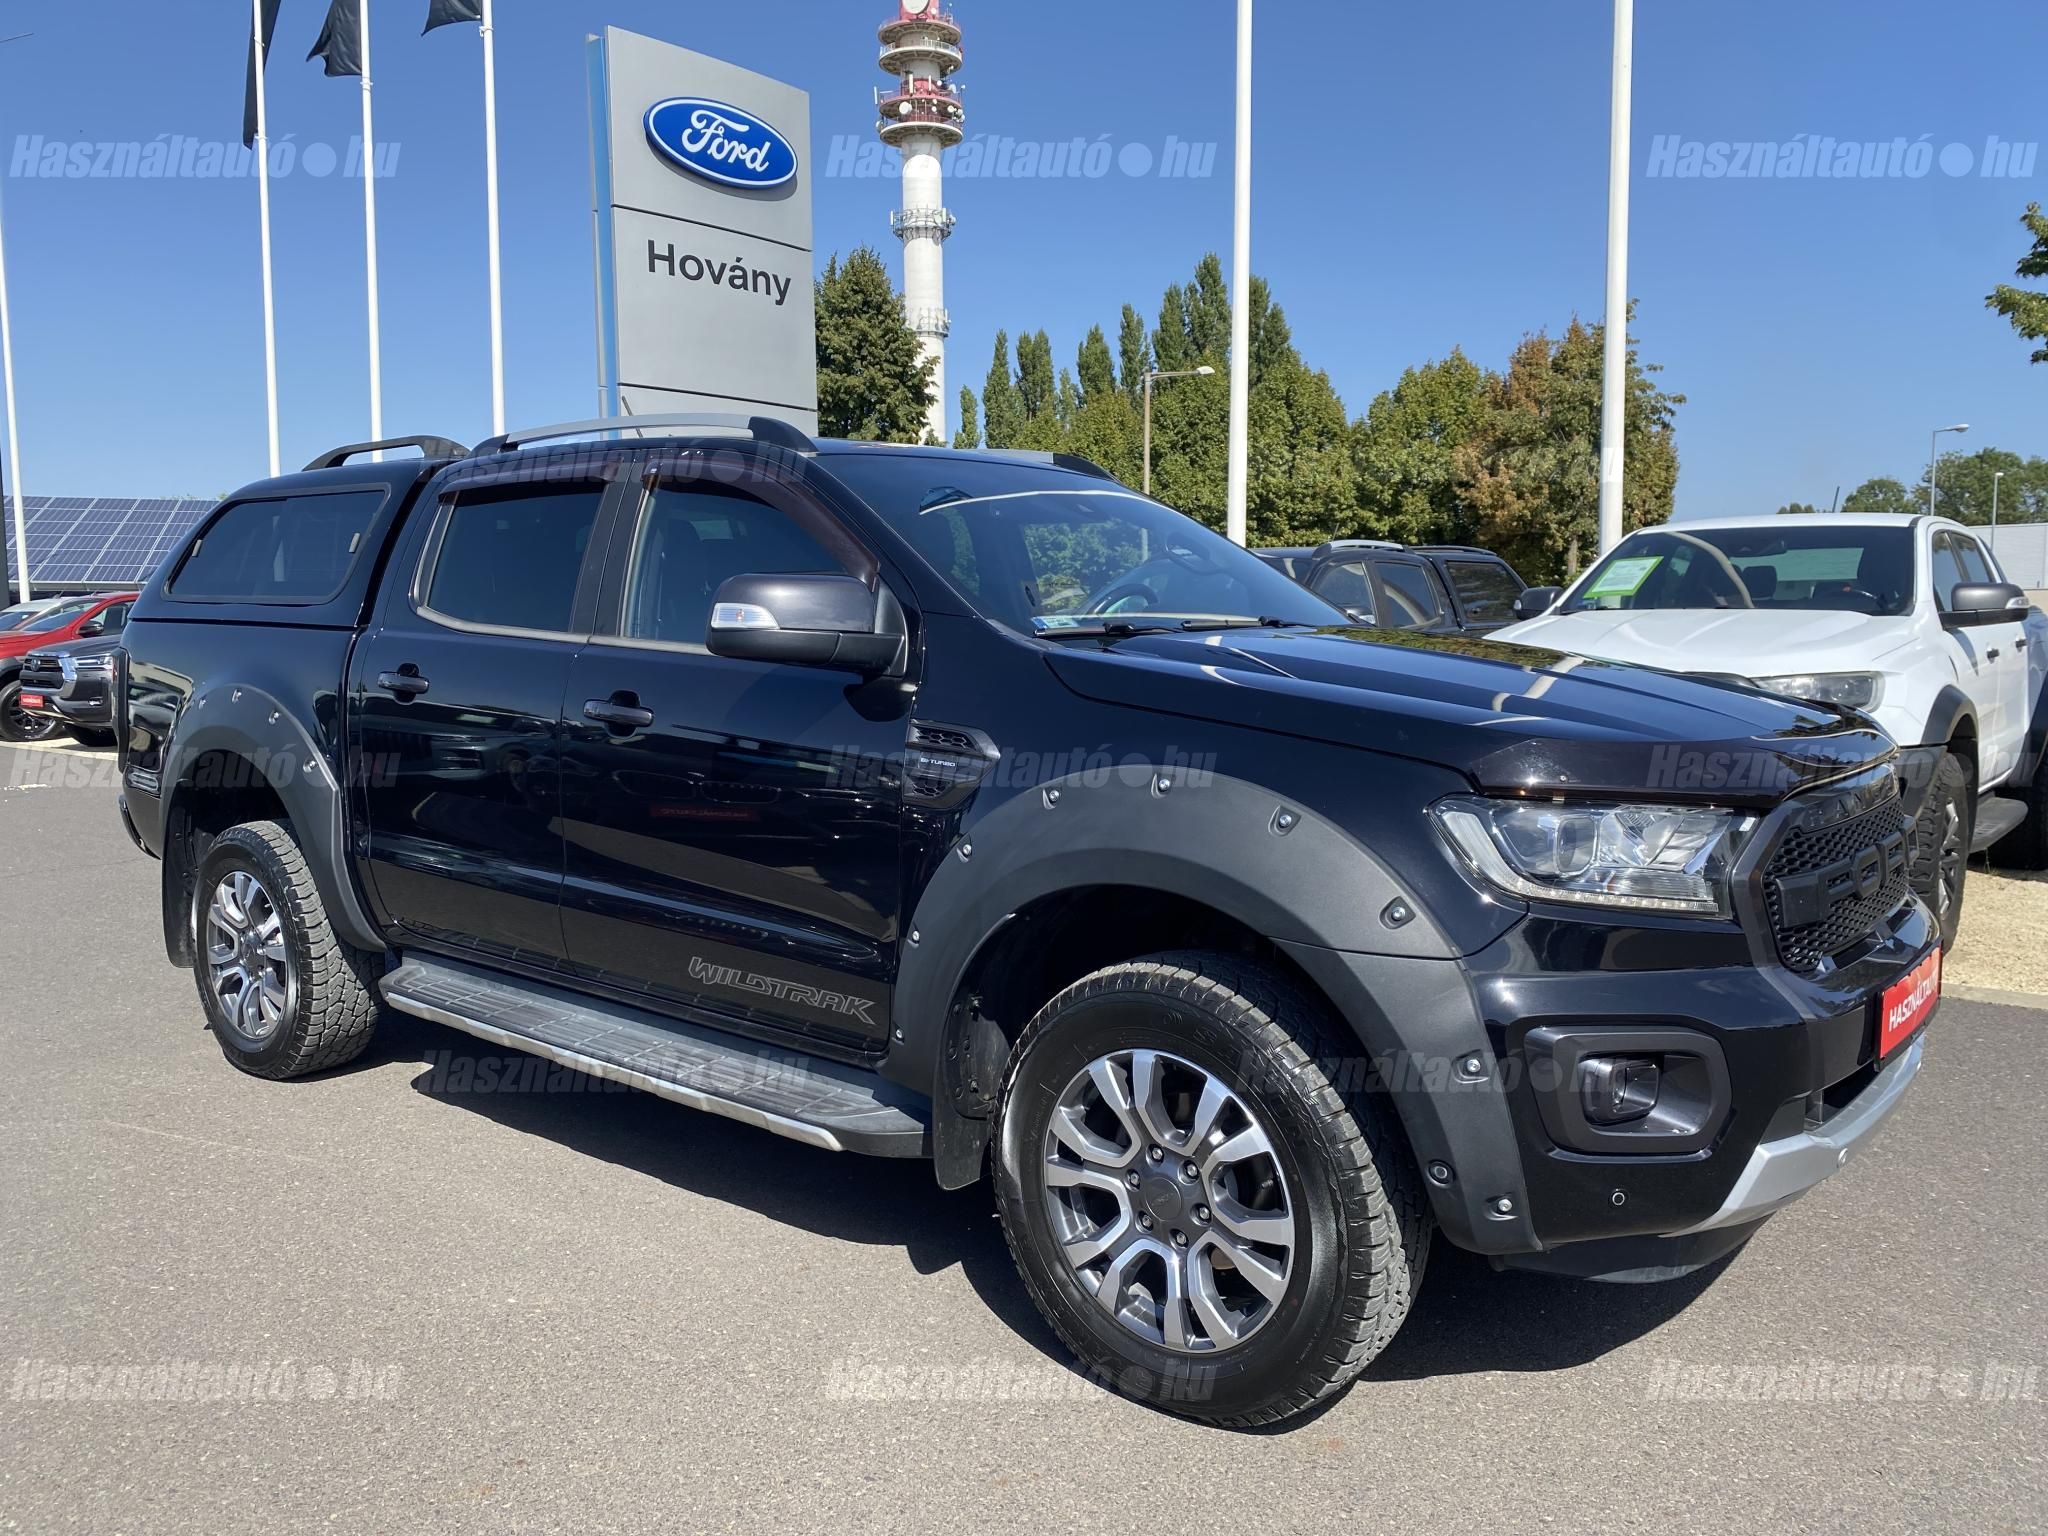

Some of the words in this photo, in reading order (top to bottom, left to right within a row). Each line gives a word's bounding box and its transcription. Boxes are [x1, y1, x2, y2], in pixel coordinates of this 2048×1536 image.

[681, 109, 770, 172] Ford
[648, 239, 791, 305] Hovány
[688, 956, 877, 1025] WILDTRAK
